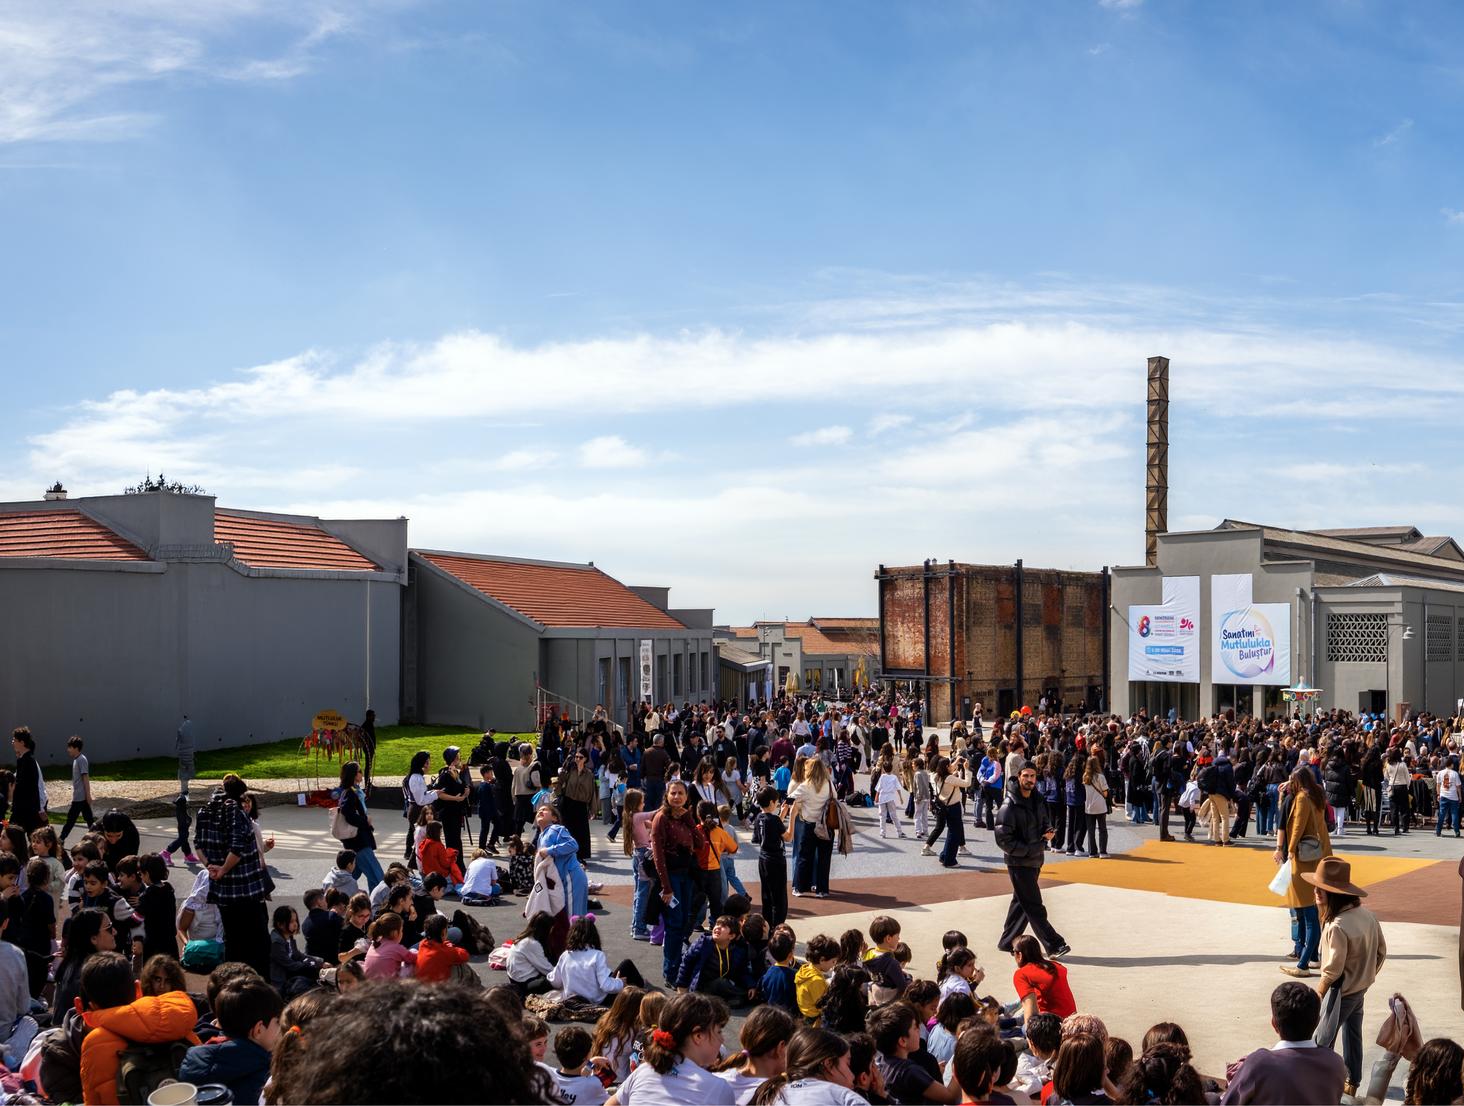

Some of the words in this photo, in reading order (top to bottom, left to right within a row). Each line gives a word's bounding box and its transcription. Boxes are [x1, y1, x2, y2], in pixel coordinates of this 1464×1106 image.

[1222, 628, 1255, 640] Sanatını
[1221, 638, 1271, 650] Mutlulukla
[1239, 647, 1272, 661] Buluştur
